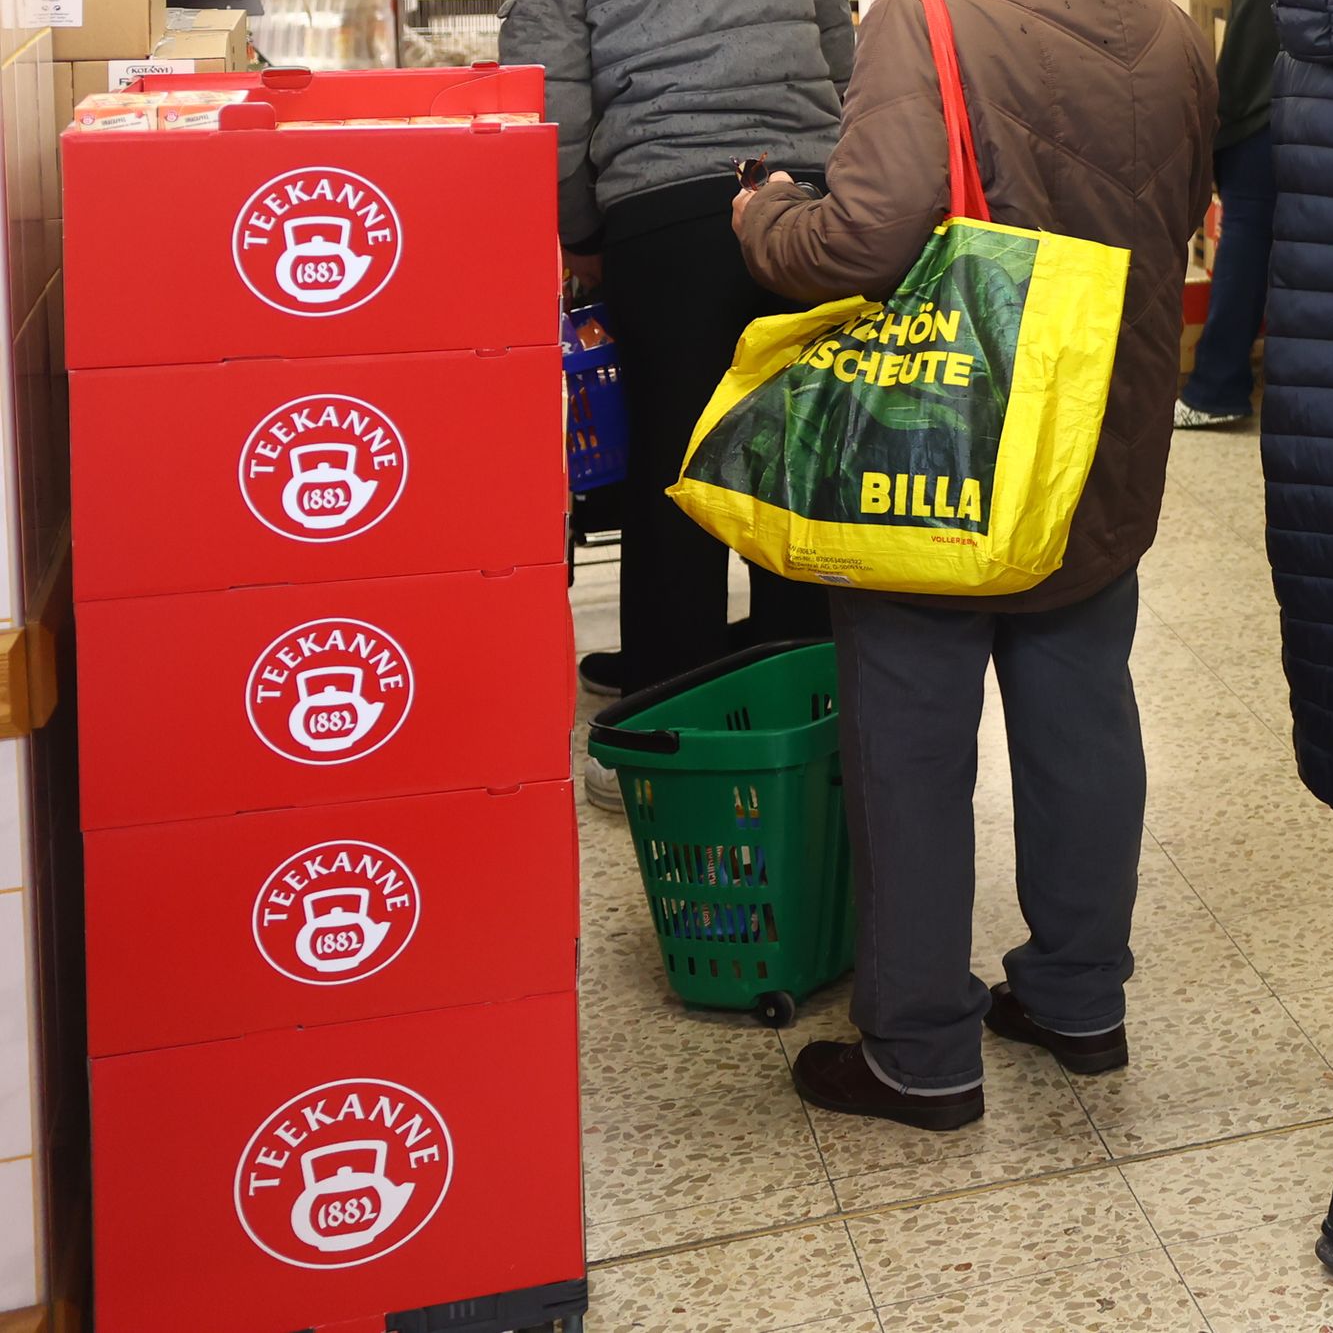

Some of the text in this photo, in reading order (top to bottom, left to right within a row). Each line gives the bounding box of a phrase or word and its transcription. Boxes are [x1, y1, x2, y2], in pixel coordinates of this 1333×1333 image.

[243, 178, 391, 251] TEEKANNE
[296, 261, 346, 285] 1882
[250, 404, 396, 479] TEEKANNE
[302, 489, 348, 511] 1882
[860, 472, 981, 521] BILLA
[931, 535, 961, 545] VOLLER
[257, 629, 404, 704] TEEKANNE
[308, 711, 356, 734] 1882
[263, 851, 411, 927] TEEKANNE
[315, 931, 364, 955] 1882
[248, 1093, 440, 1196] TEEKANNE
[317, 1194, 380, 1228] 1882
